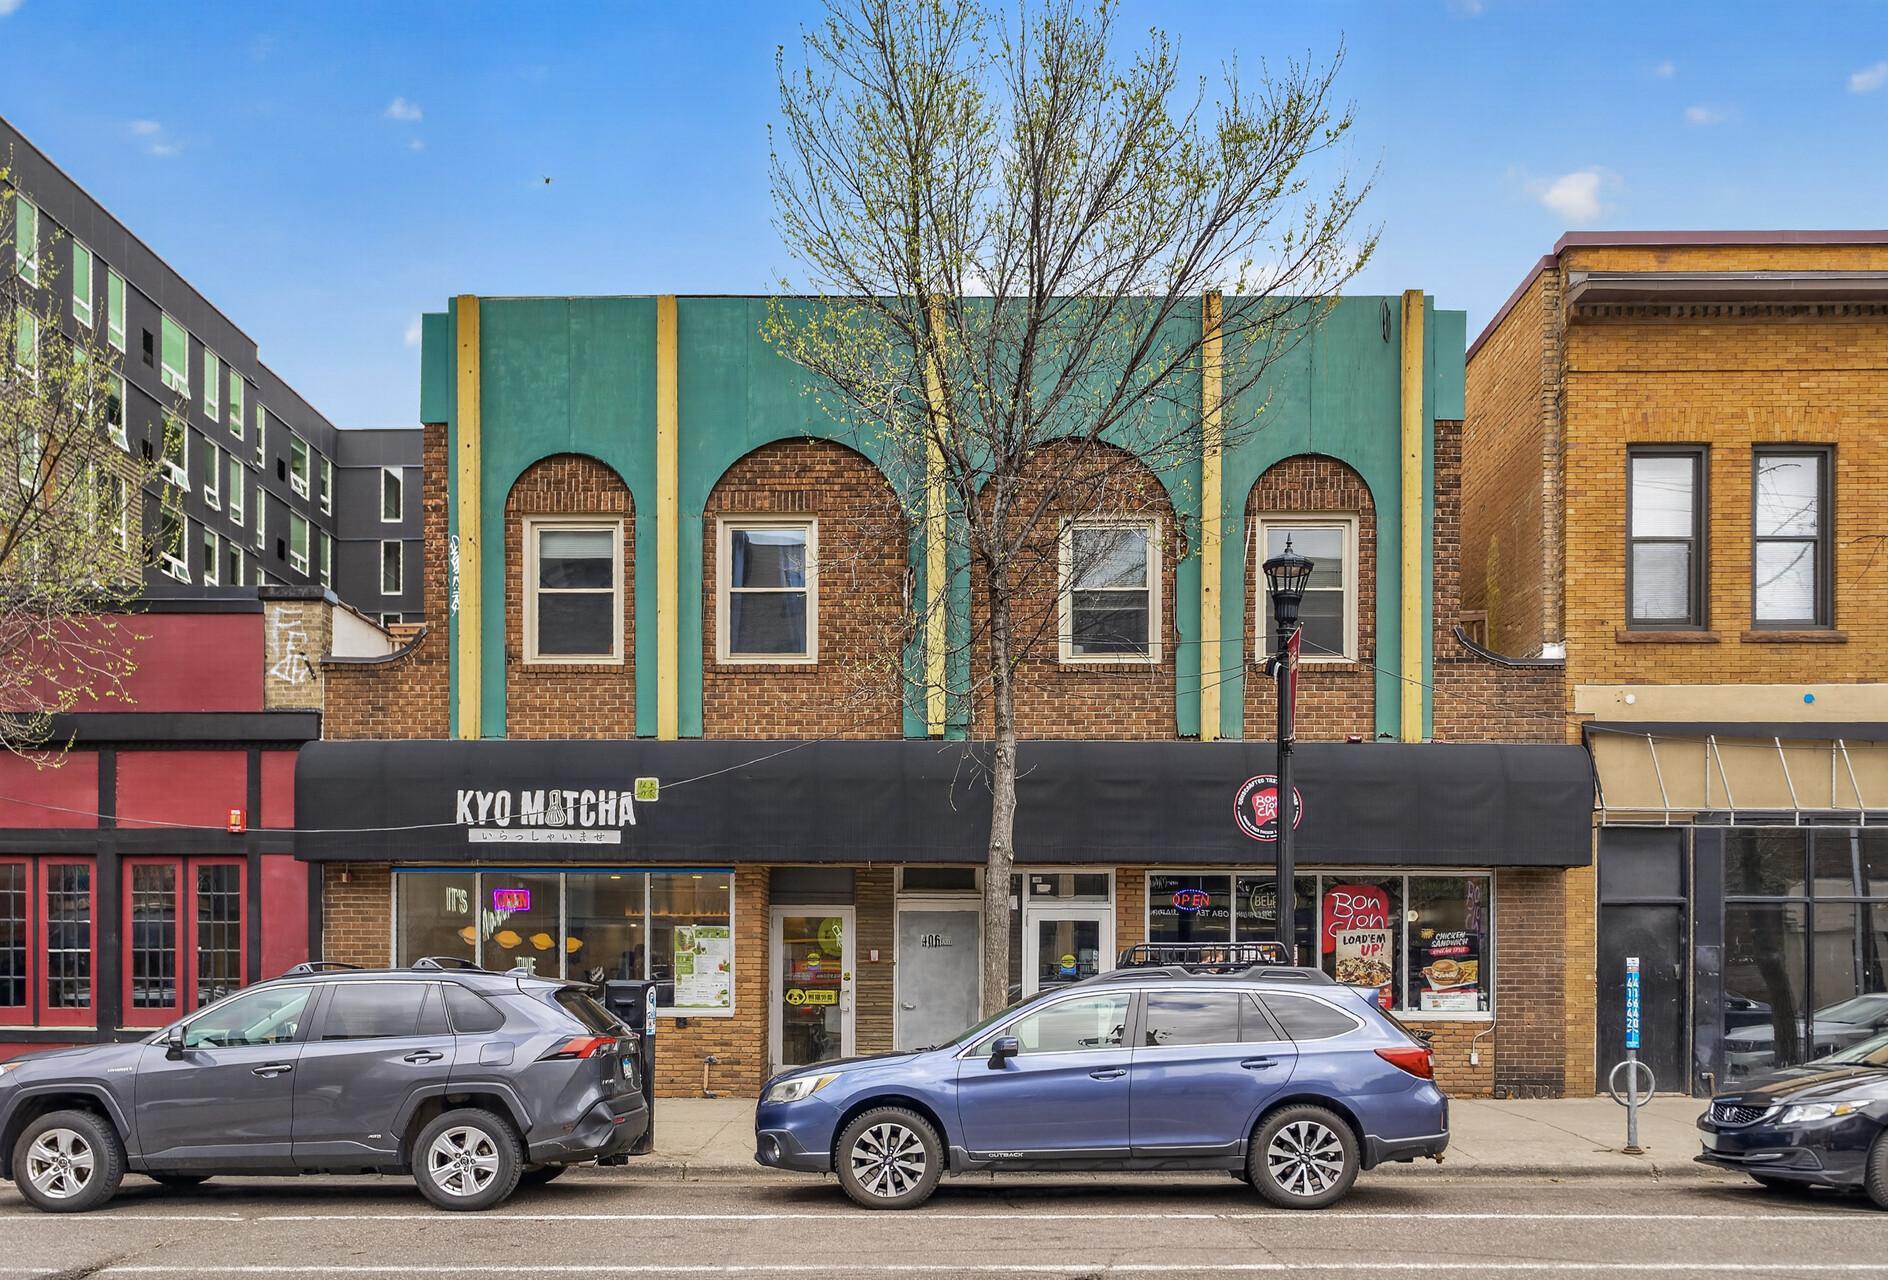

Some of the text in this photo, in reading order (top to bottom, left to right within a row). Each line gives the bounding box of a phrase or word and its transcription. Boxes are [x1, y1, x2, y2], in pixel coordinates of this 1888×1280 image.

[456, 789, 512, 827] KYO
[482, 830, 605, 842] いらっしゃいませ
[1171, 894, 1211, 907] OPEN
[1331, 892, 1380, 918] Bon
[1342, 933, 1386, 946] LOAD'EM
[1435, 931, 1466, 940] CHICKEN
[1431, 938, 1469, 948] SANDWICH
[1360, 943, 1384, 957] UP!
